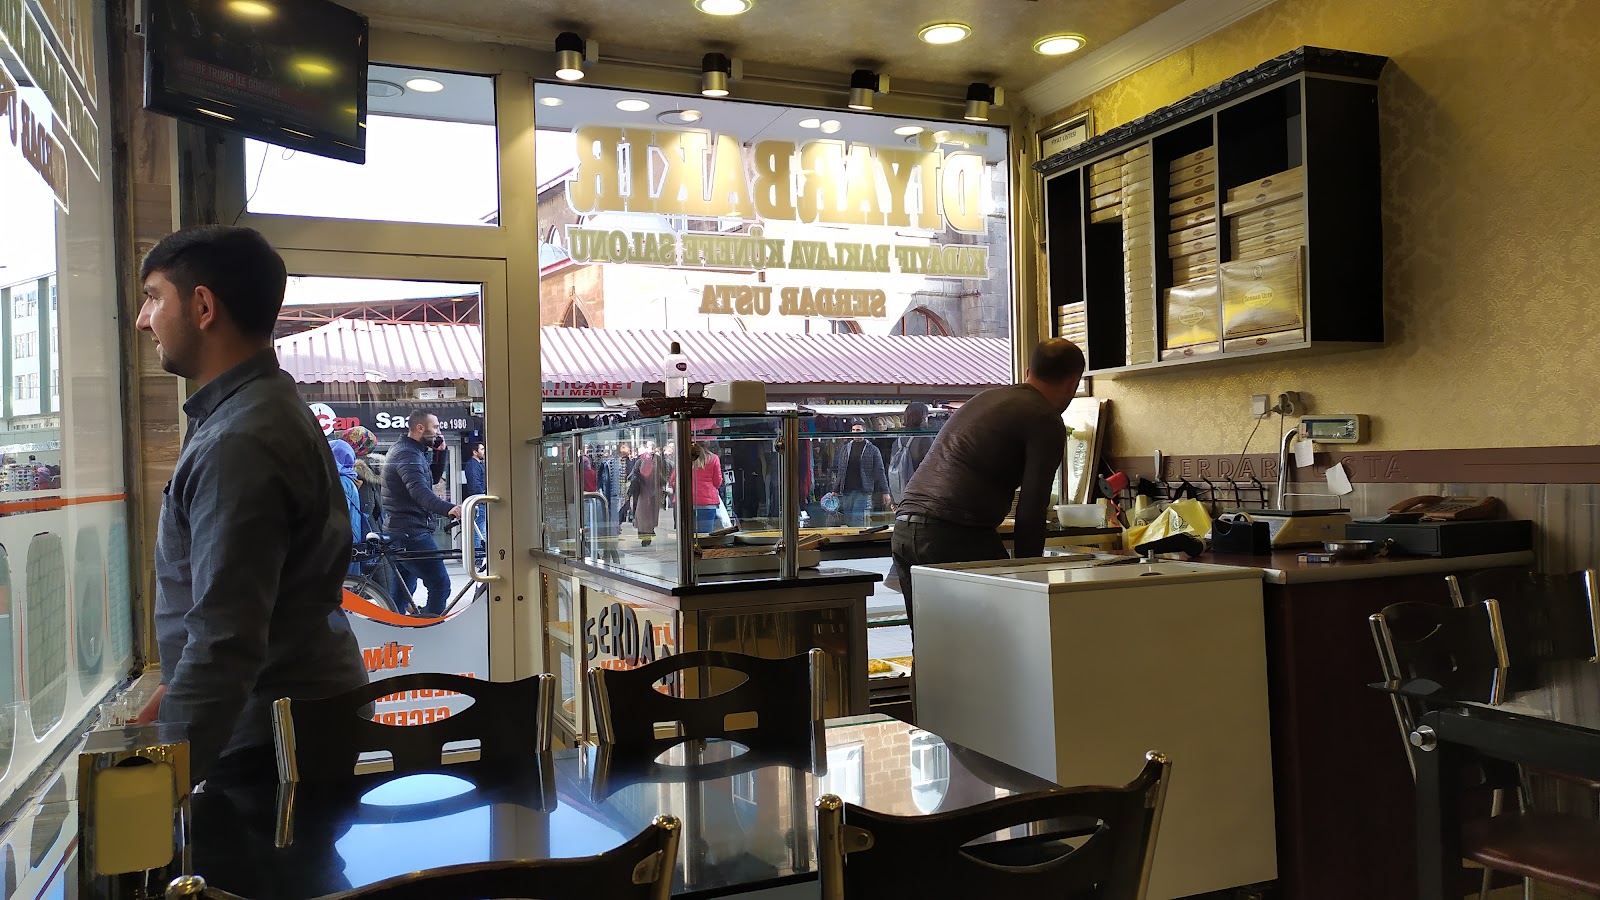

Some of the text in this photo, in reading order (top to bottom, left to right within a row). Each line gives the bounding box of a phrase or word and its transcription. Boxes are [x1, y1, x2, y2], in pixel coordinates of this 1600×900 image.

[209, 65, 233, 82] TRUMP
[316, 414, 360, 430] Can
[450, 418, 467, 430] 1980
[1167, 456, 1278, 478] SERDAR
